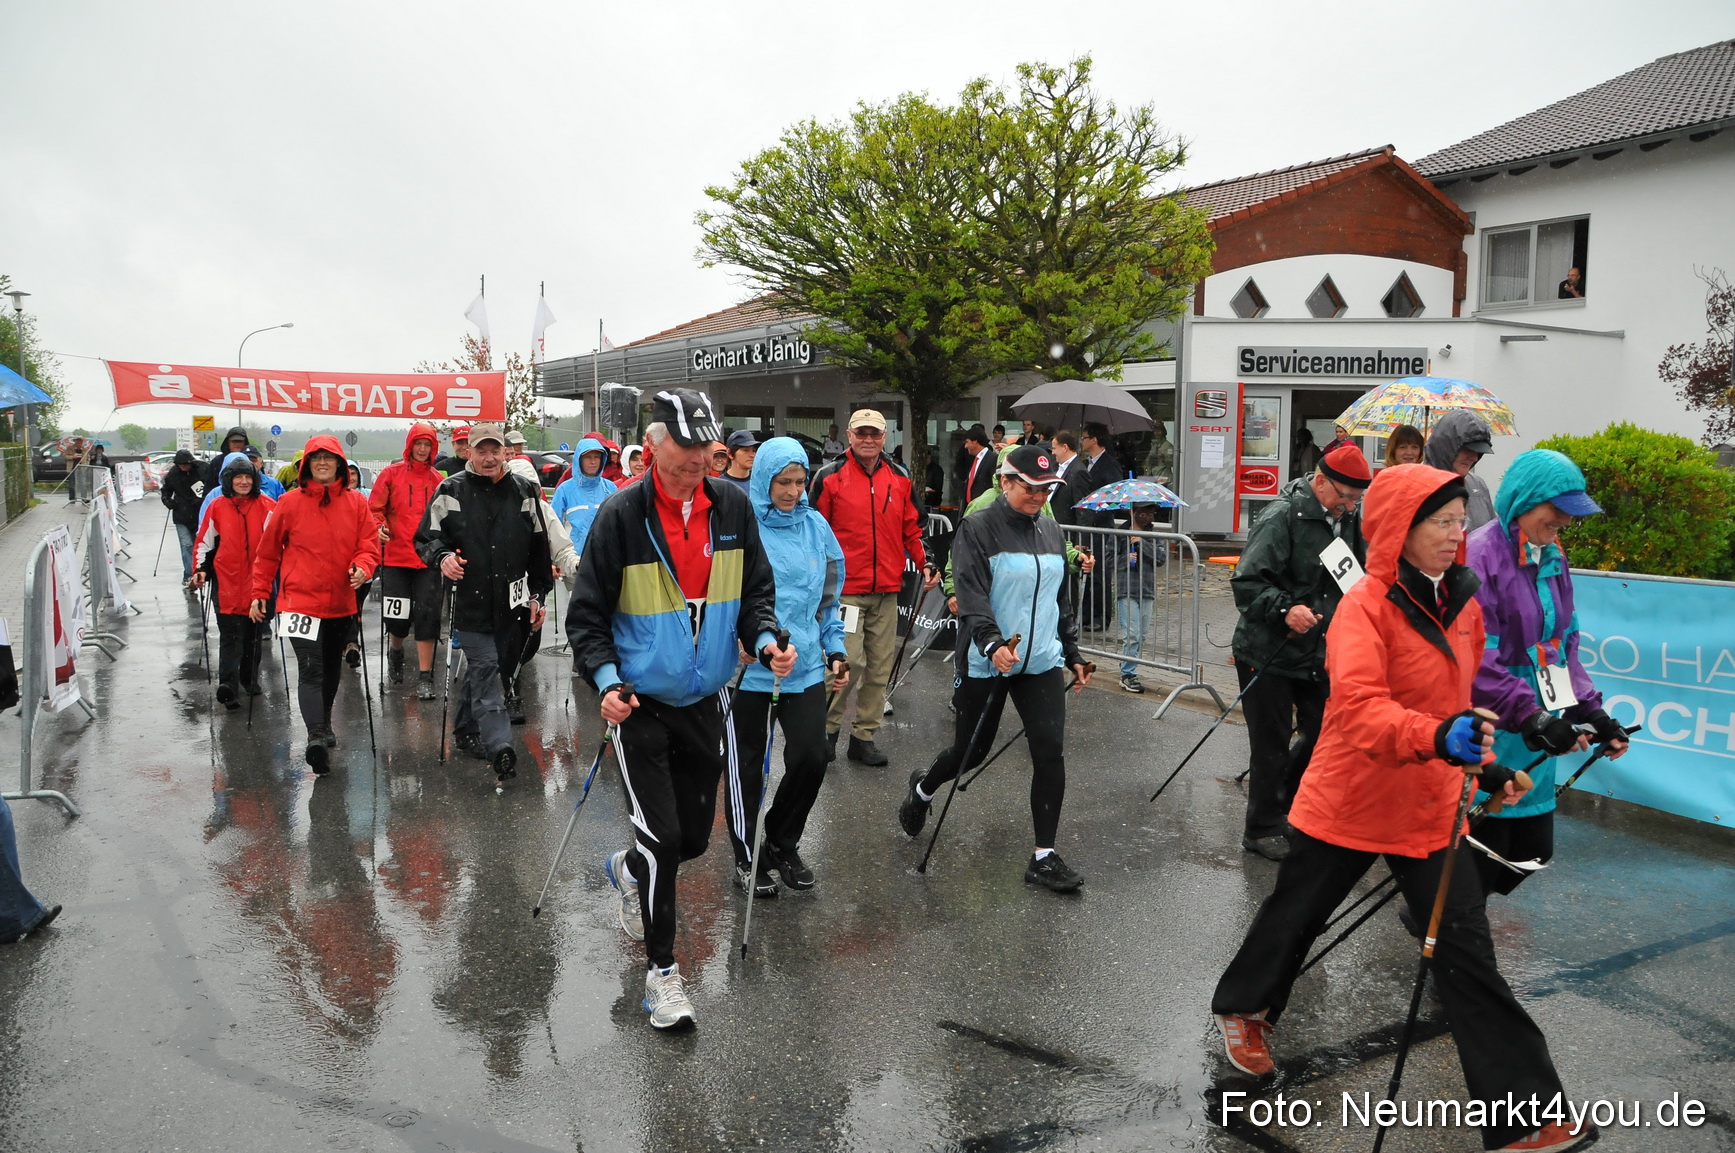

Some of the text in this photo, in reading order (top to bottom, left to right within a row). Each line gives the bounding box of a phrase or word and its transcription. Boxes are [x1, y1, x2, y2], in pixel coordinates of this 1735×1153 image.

[693, 336, 811, 371] Gerhart & Jänig
[1239, 348, 1424, 375] Serviceannahme
[1189, 425, 1232, 433] SEAT
[1332, 556, 1354, 581] 5
[512, 579, 524, 603] 39
[386, 598, 403, 616] 79
[287, 613, 312, 635] 38
[1540, 666, 1557, 703] 3
[1602, 694, 1735, 751] OCH
